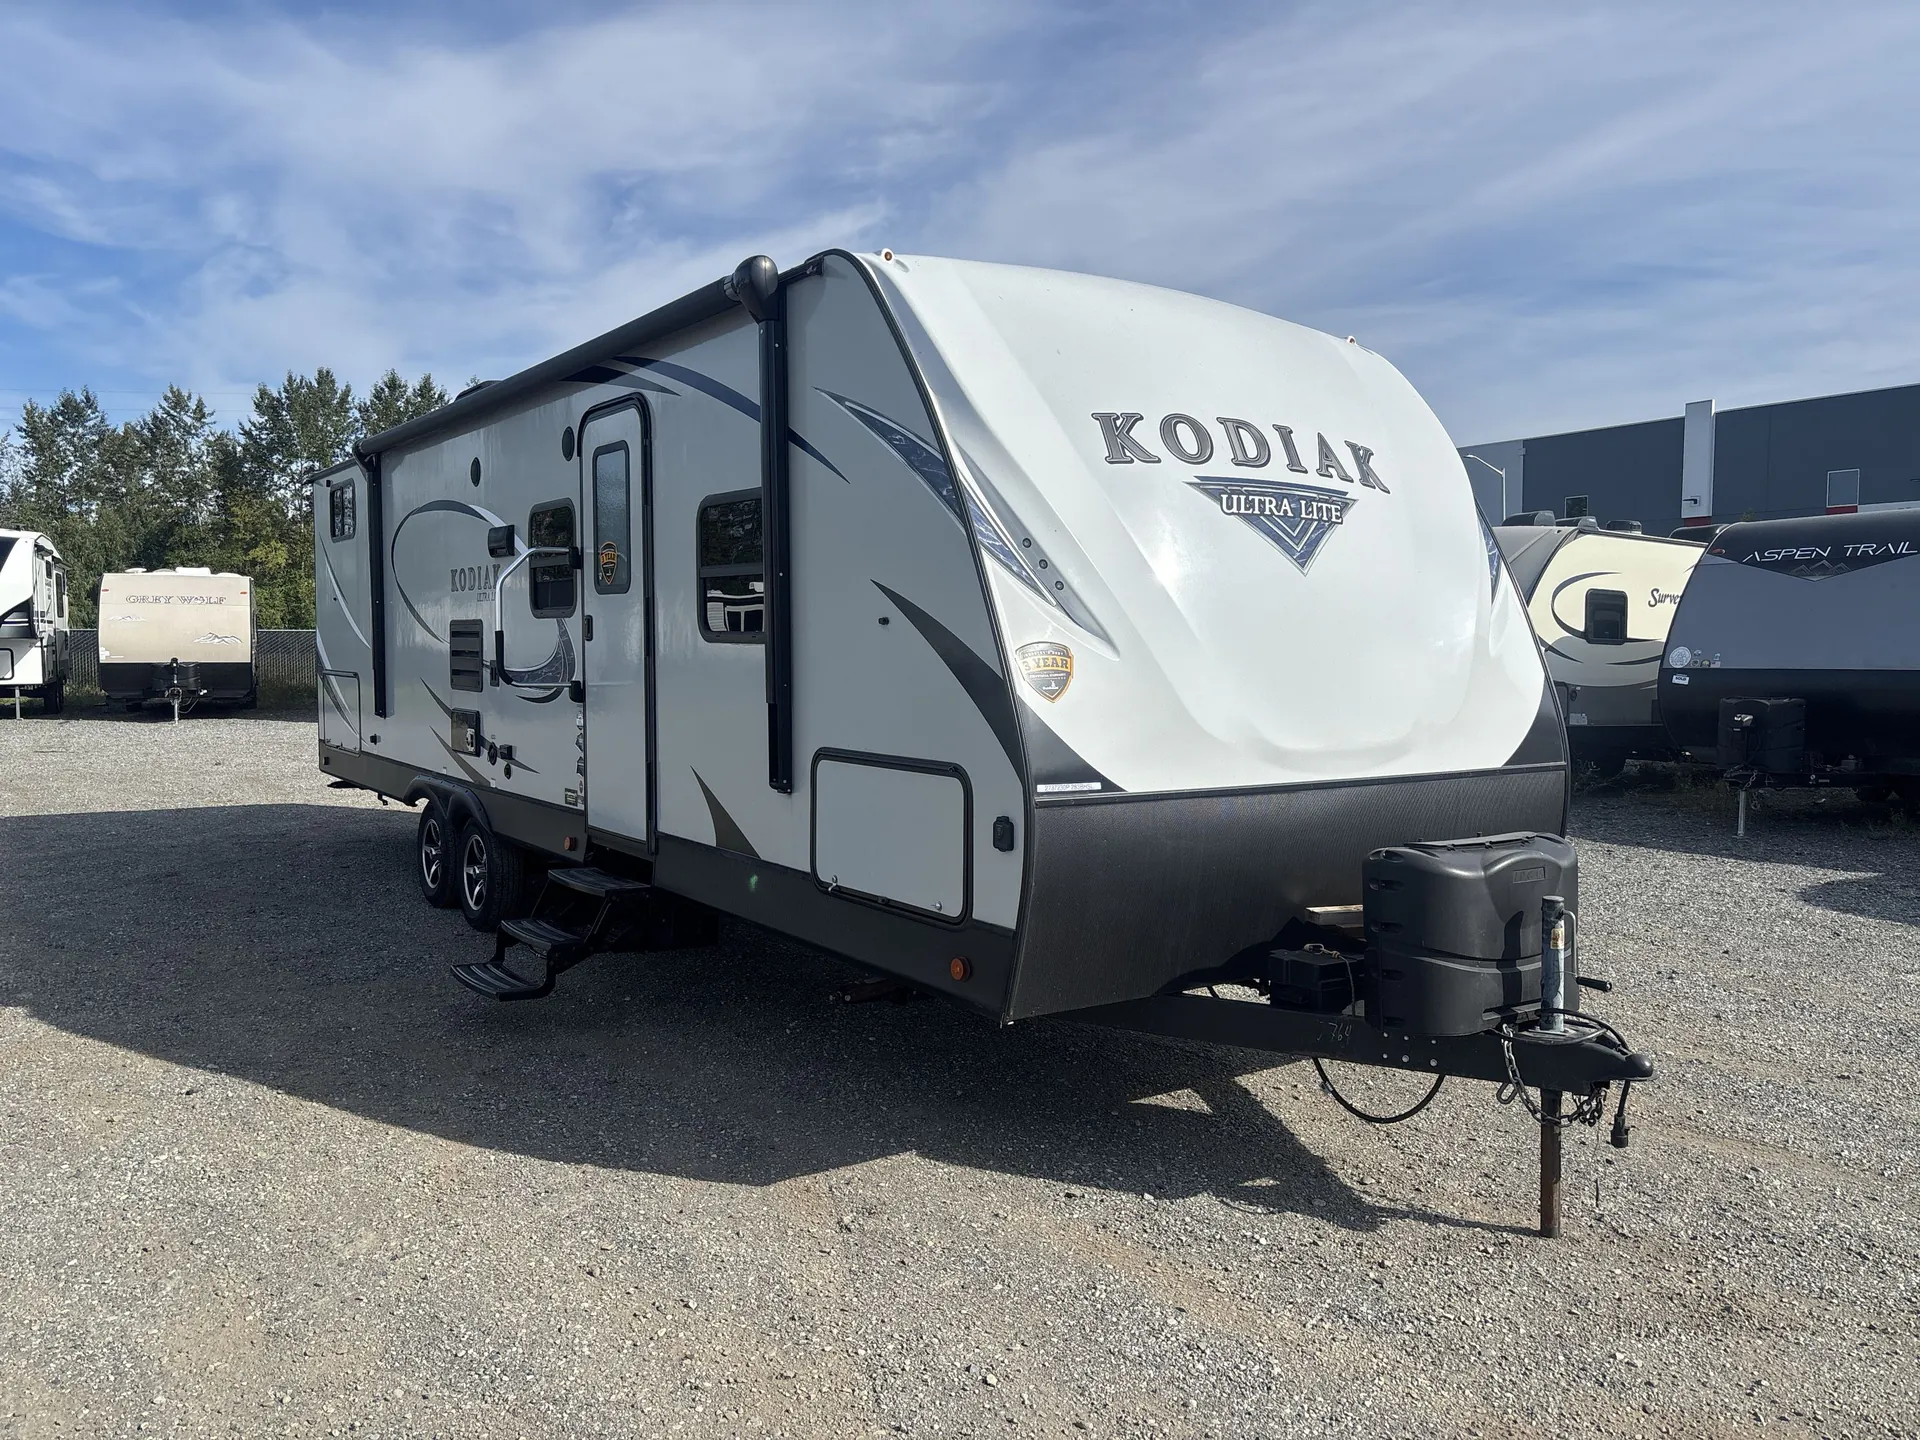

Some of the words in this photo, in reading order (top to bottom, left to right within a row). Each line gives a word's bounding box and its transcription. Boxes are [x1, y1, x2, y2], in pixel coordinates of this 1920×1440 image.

[1091, 412, 1391, 494] KODIAK
[1220, 493, 1294, 518] ULTRA
[1299, 499, 1343, 524] LITE
[1742, 546, 1832, 563] ASPEN
[1843, 541, 1918, 557] TRAIL
[125, 595, 174, 604] GREY
[176, 595, 227, 605] WOLF
[1648, 588, 1681, 608] Surve
[1022, 660, 1031, 671] 3
[1032, 656, 1069, 669] YEAR
